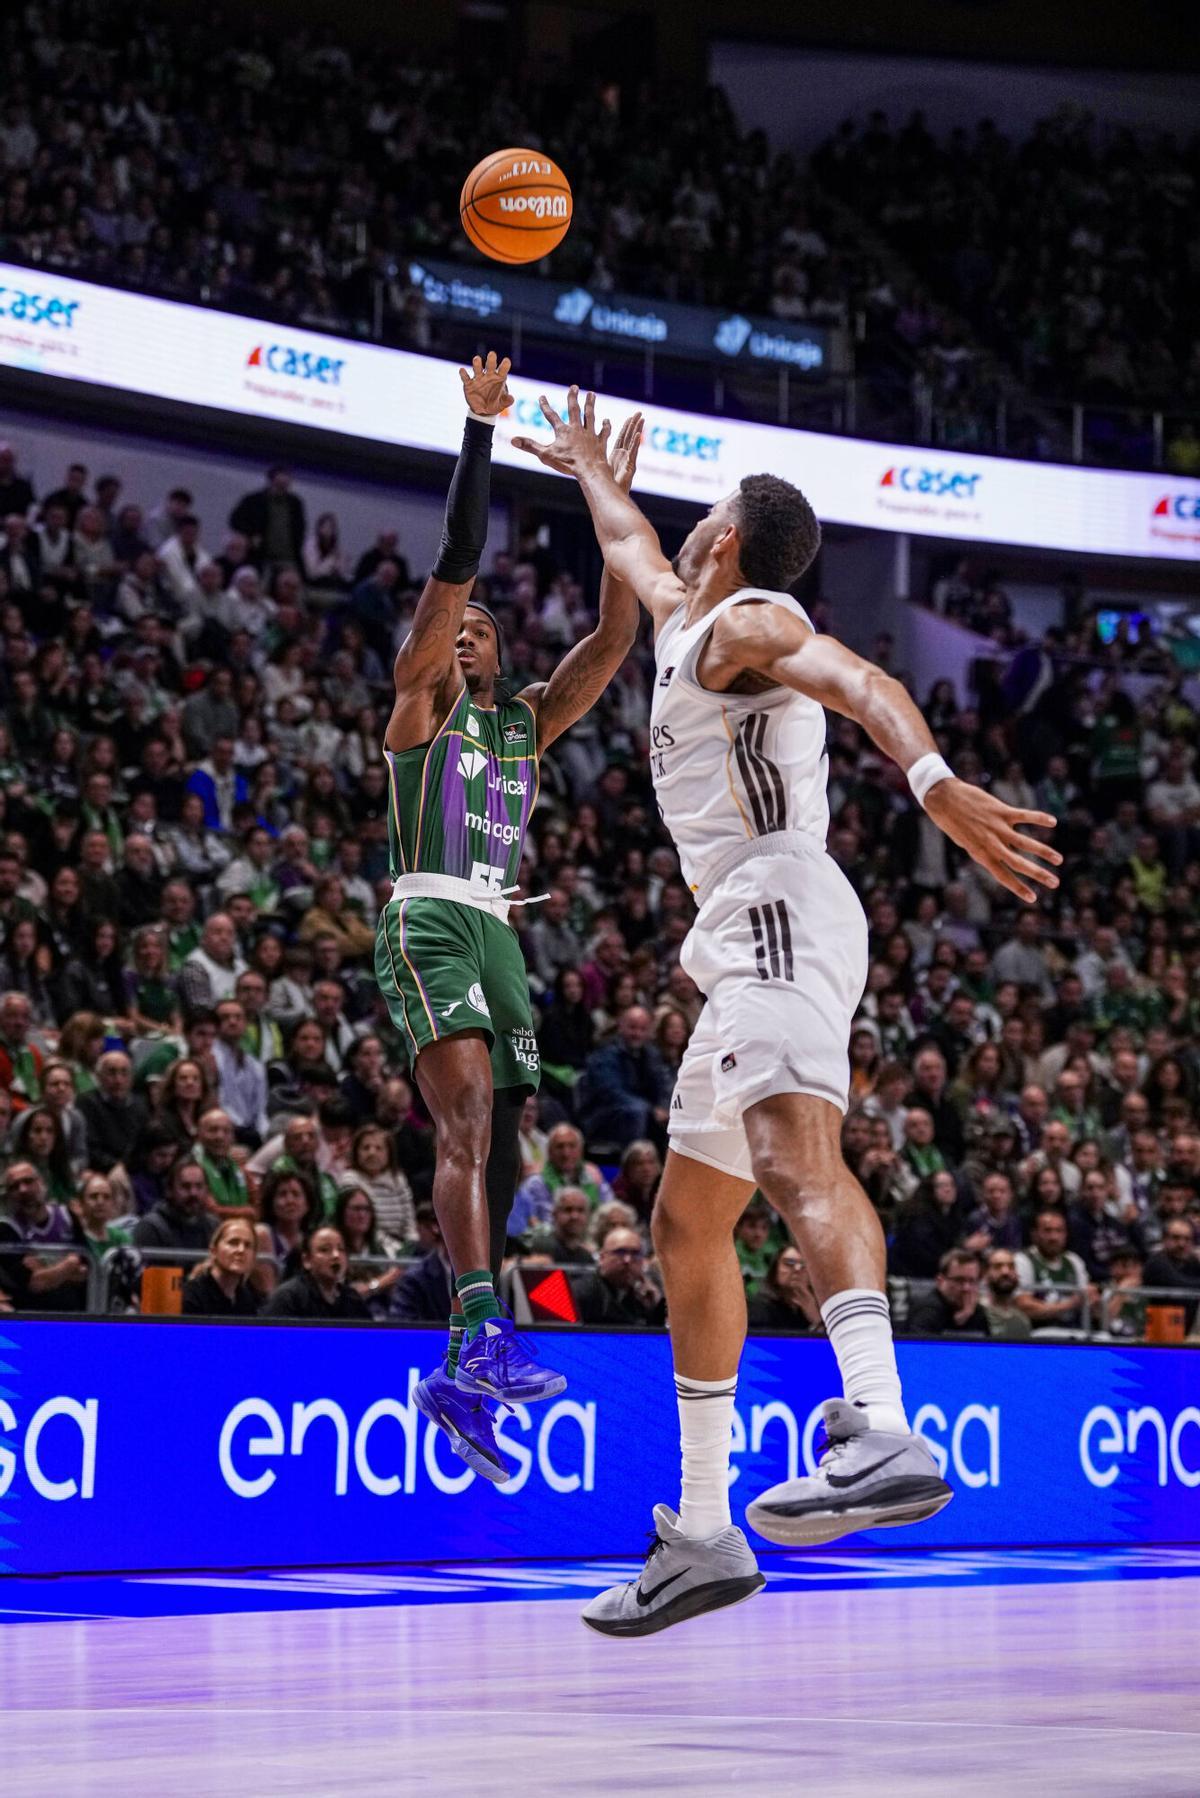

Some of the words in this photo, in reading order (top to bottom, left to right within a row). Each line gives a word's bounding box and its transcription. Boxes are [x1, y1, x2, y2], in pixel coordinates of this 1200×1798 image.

[499, 195, 567, 218] Wilson
[266, 344, 345, 384] caser
[900, 467, 981, 497] caser
